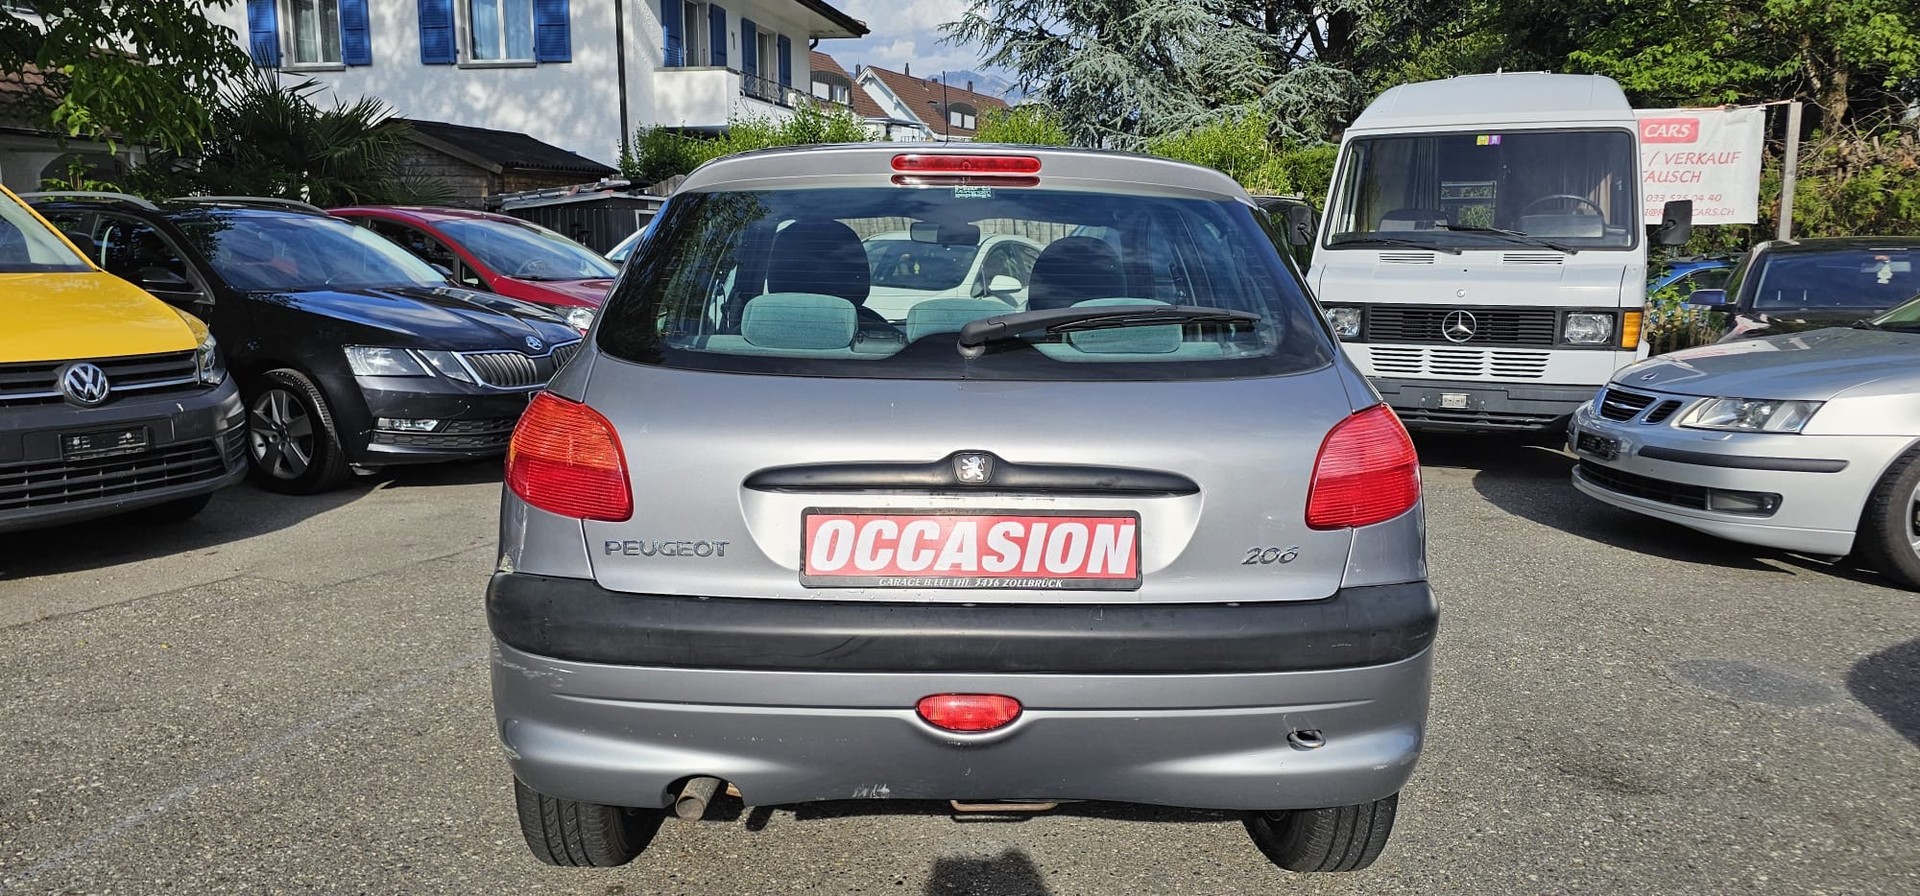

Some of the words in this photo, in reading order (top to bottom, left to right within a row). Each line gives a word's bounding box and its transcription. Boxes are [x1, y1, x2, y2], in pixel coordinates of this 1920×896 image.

[1644, 124, 1691, 138] CARS
[1664, 151, 1743, 165] VERKAUF
[1645, 194, 1665, 203] 033
[1707, 194, 1722, 202] 40
[604, 540, 730, 557] PEUGEOT
[809, 518, 1136, 574] OCCASION
[1241, 545, 1299, 565] 206
[879, 578, 921, 587] GARAGE
[1002, 577, 1064, 588] ZOLLBRÜCK
